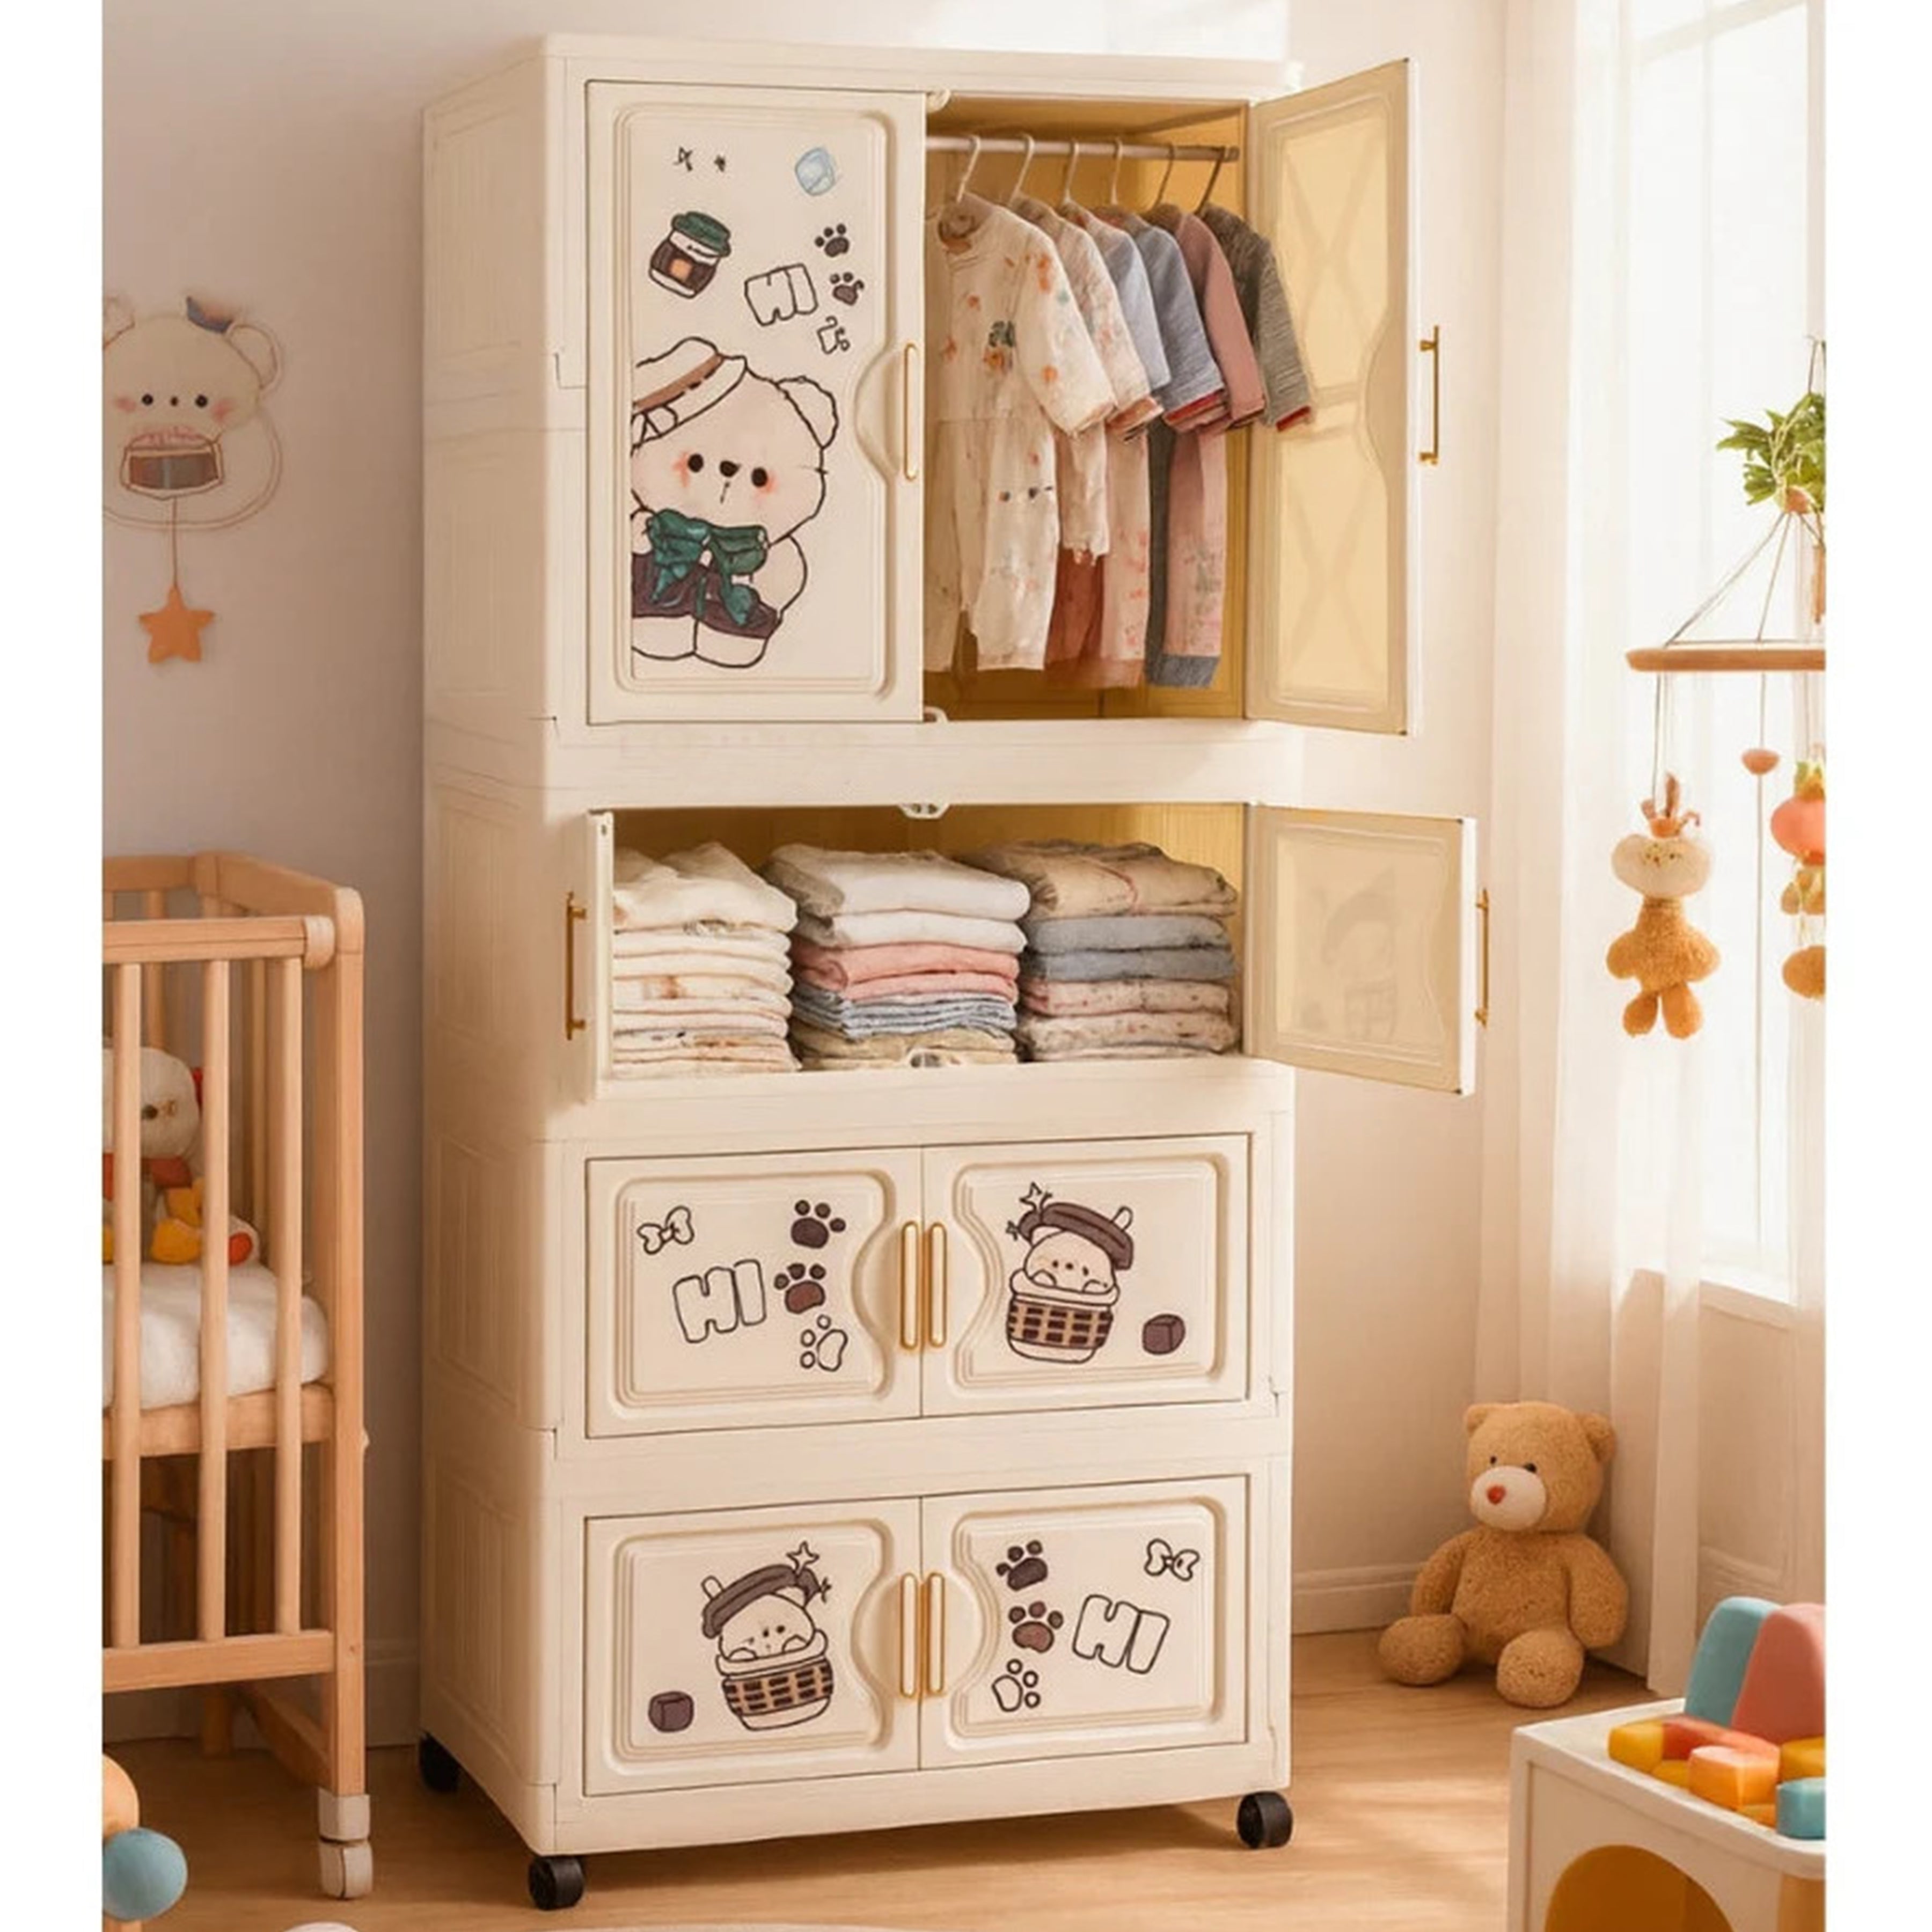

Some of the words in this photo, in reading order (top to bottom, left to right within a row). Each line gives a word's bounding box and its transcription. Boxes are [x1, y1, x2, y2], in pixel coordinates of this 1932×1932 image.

[744, 263, 818, 325] HI
[672, 1259, 766, 1343] HI
[1072, 1594, 1170, 1674] HI
